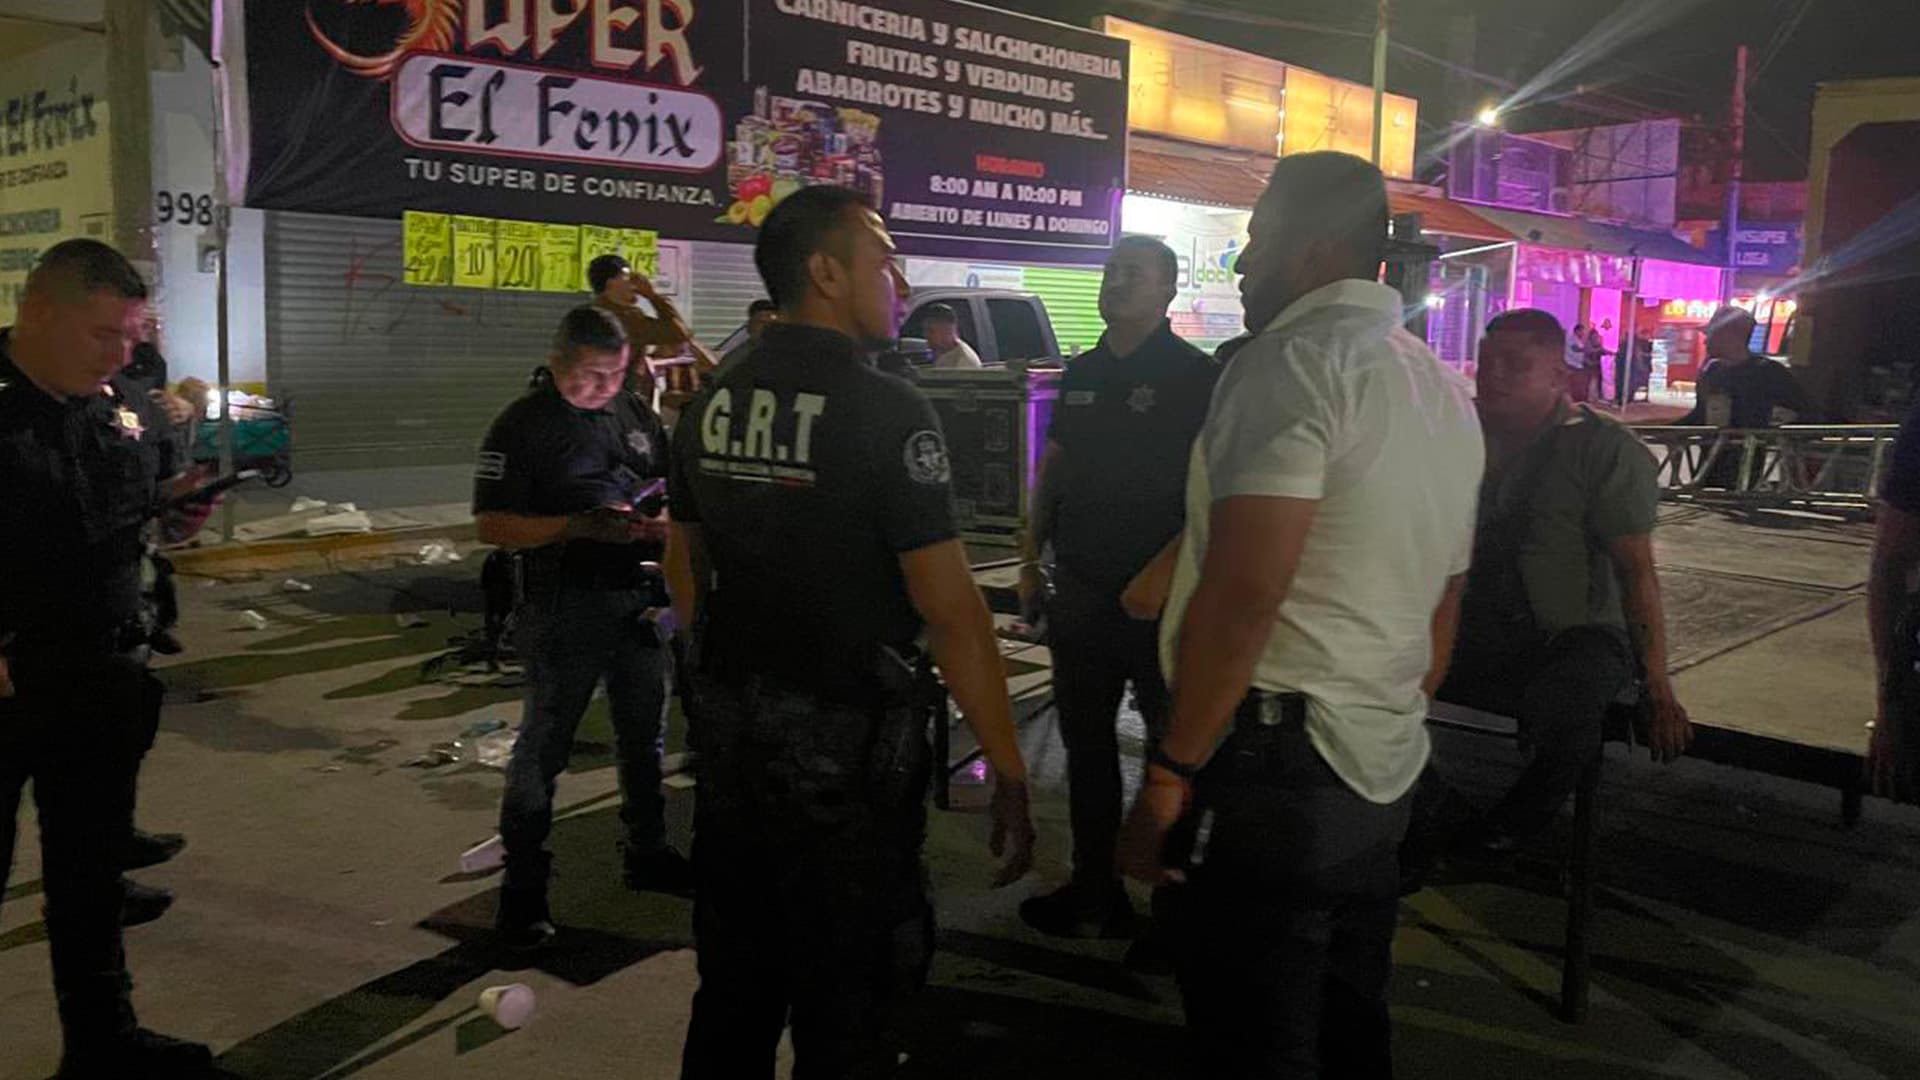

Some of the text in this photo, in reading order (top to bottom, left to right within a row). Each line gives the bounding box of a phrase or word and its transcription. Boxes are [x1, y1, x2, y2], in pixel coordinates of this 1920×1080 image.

[775, 0, 927, 41] CARNICERIA
[955, 27, 1122, 80] SALCHICHONERIA
[846, 40, 938, 78] FRUTAS
[965, 63, 1074, 101] VERDURAS
[428, 65, 697, 157] El Fenix
[796, 68, 943, 114] ABARROTES
[969, 97, 1046, 131] MUCHO
[405, 158, 441, 181] TU
[450, 163, 535, 190] SUPER
[544, 174, 575, 193] DE
[930, 175, 1082, 207] 8:00 AM A 10:00 PM
[889, 202, 1110, 235] ABIERTO DE LUNES A DOMINGO
[702, 388, 826, 463] G.R.T
